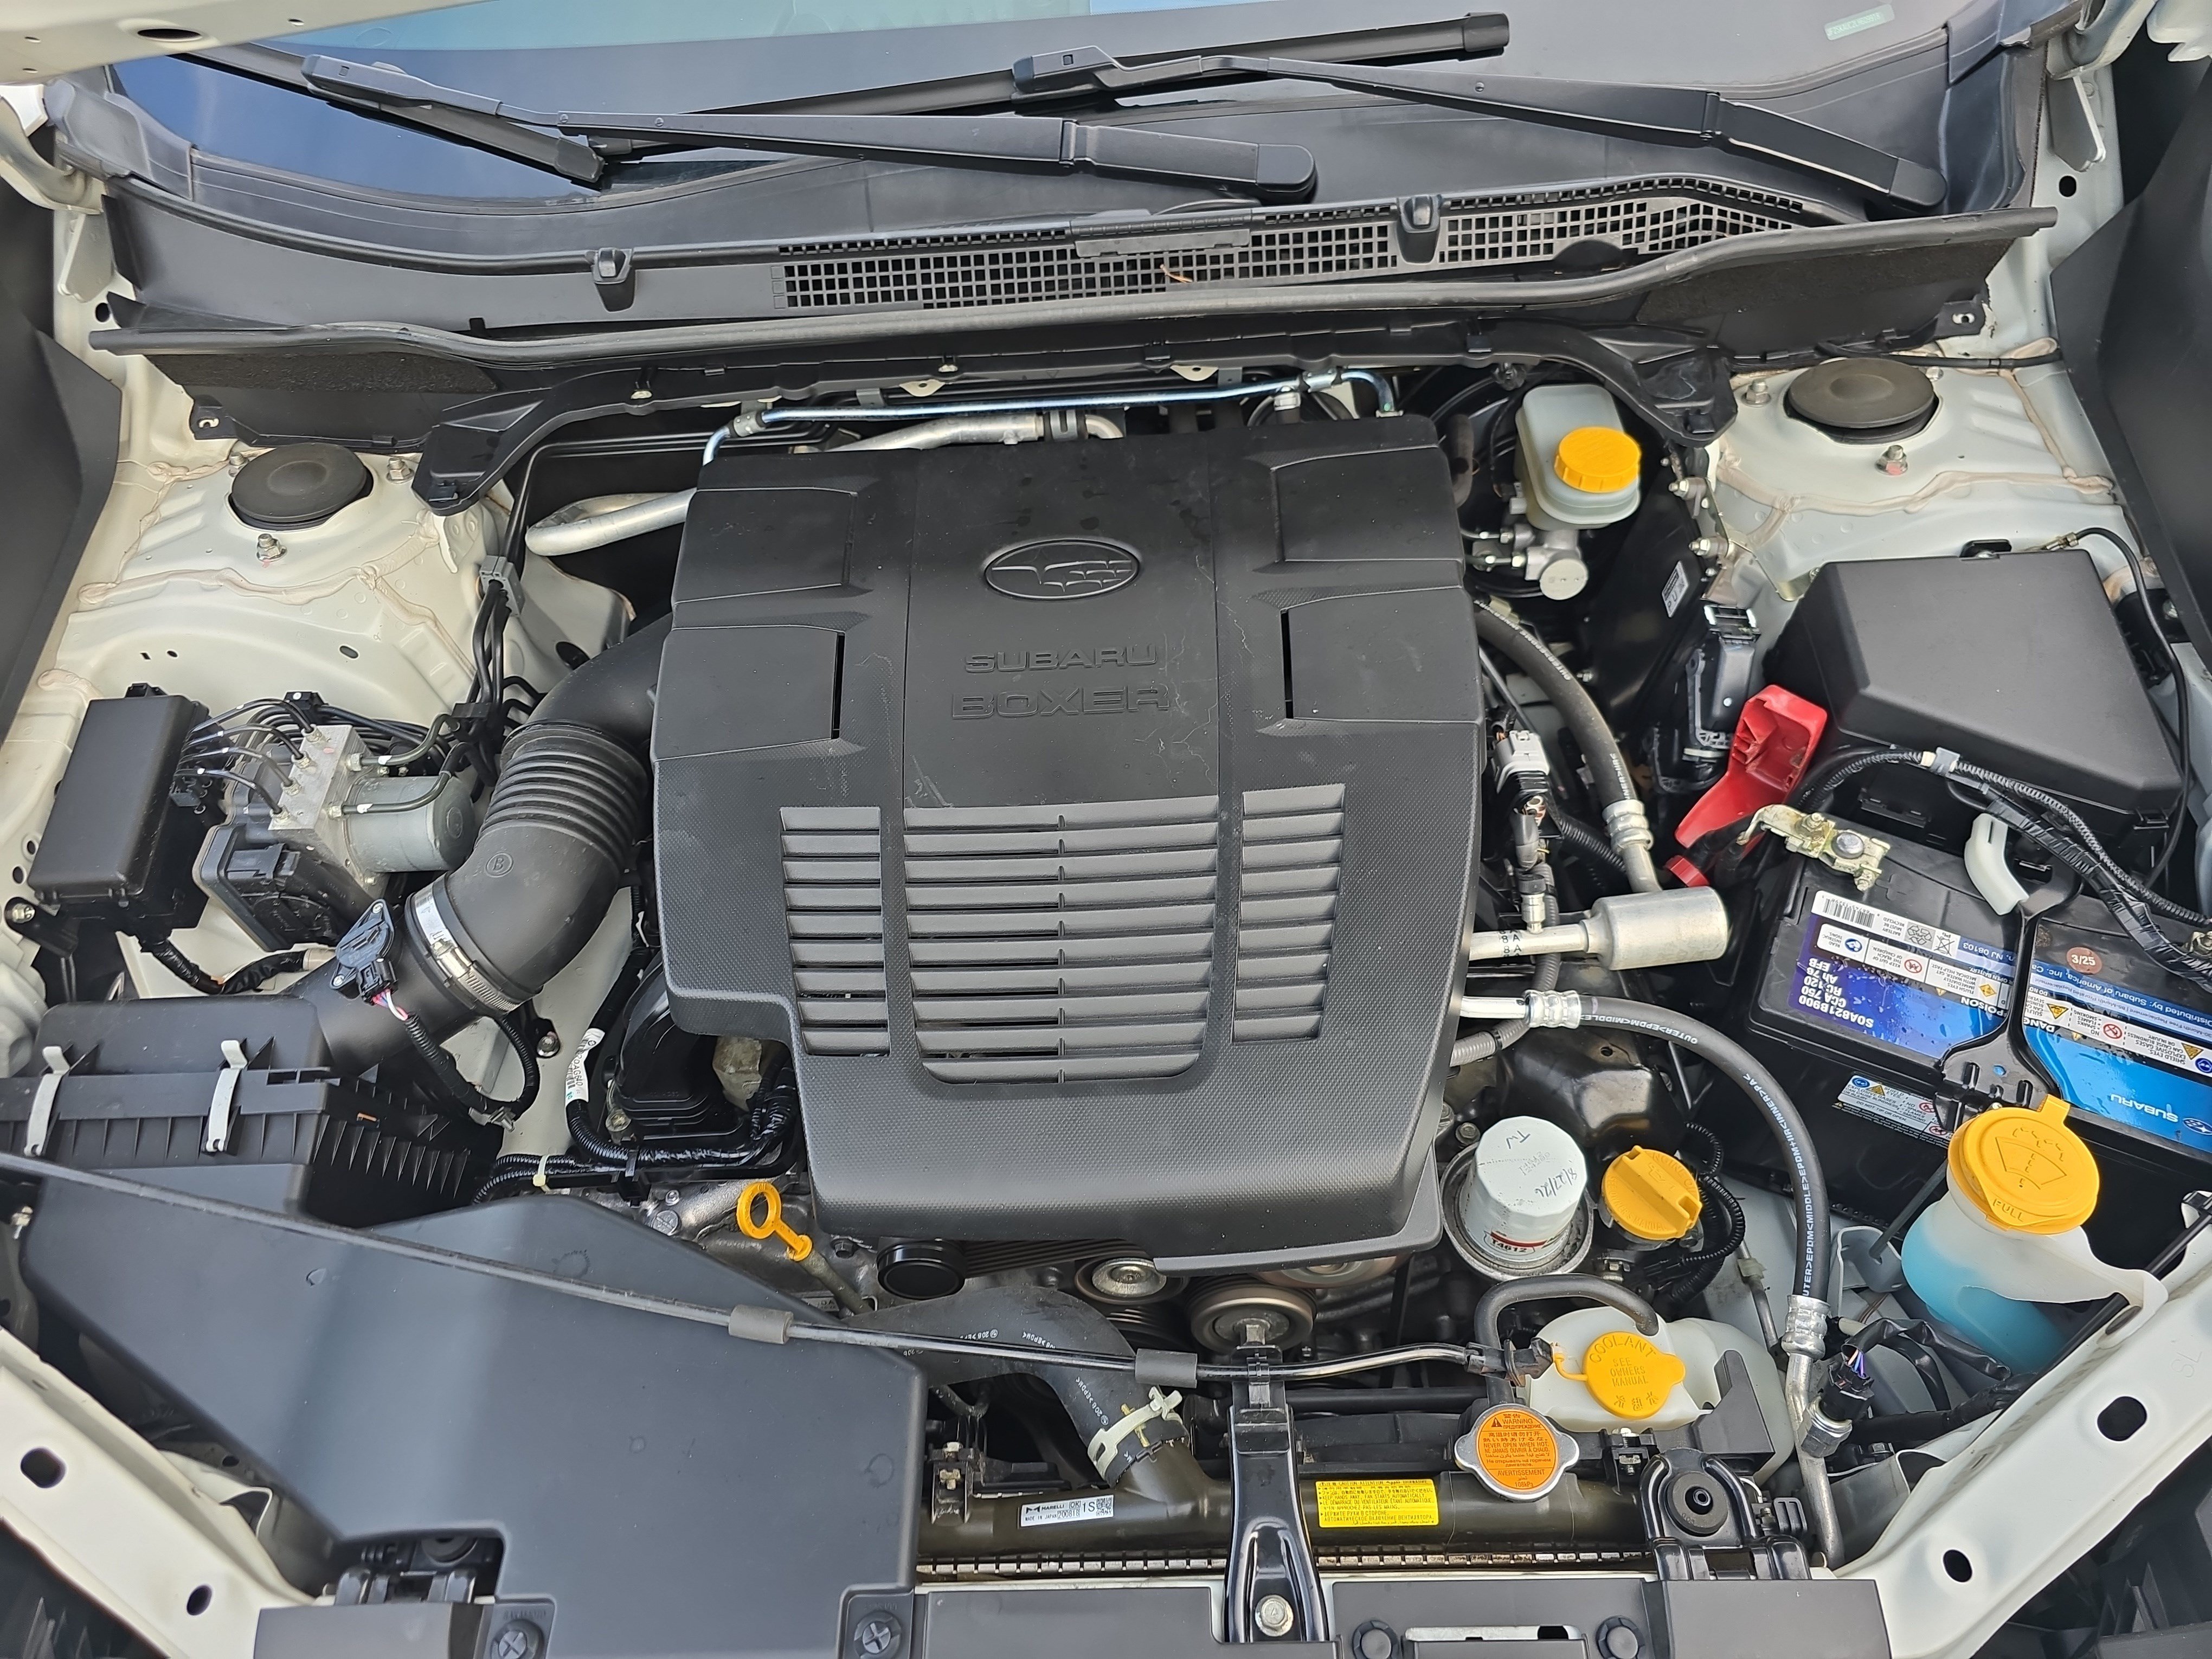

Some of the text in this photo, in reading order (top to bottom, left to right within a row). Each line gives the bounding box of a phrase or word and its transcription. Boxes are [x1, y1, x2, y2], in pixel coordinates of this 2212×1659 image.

[964, 644, 1158, 676] SUBARU
[951, 681, 1169, 721] BOXER
[1962, 941, 2003, 960] NJ 08103
[1808, 957, 1830, 972] EFB
[2070, 954, 2096, 966] 3/25
[1821, 972, 1838, 985] Ah
[1955, 970, 1976, 981] MEDICAL
[1803, 975, 1842, 996] RC 120
[1943, 976, 1975, 989] IMMEDIATELY
[1801, 985, 1847, 1007] CCA 750
[1958, 986, 1974, 994] FLUSH
[2045, 967, 2212, 1026] Distributed by: Subaru of America, Inc.
[1797, 994, 1874, 1028] SOA821B900
[2073, 1009, 2097, 1020] SMOKING
[2076, 1019, 2096, 1030] SPARKS
[2077, 1015, 2097, 1025] FLAMES
[2126, 1032, 2155, 1044] BLINDNESS
[2134, 1039, 2186, 1059] EXPLOSIVE GASES
[2164, 1053, 2186, 1064] SHIELD
[1847, 1084, 1877, 1097] EXPLOSIVE
[2109, 1093, 2179, 1123] SUBARU
[1742, 1073, 1816, 1297] UTER>EPDM<MIDDLE>EPDM+IIR<INNER>PA<
[1491, 1238, 1527, 1252] T4612
[1589, 1334, 1656, 1364] COOLANT
[1613, 1357, 1631, 1367] SEE
[1610, 1365, 1645, 1377] OWNERS
[1612, 1375, 1648, 1387] MANUAL
[1082, 1501, 1096, 1512] 1S
